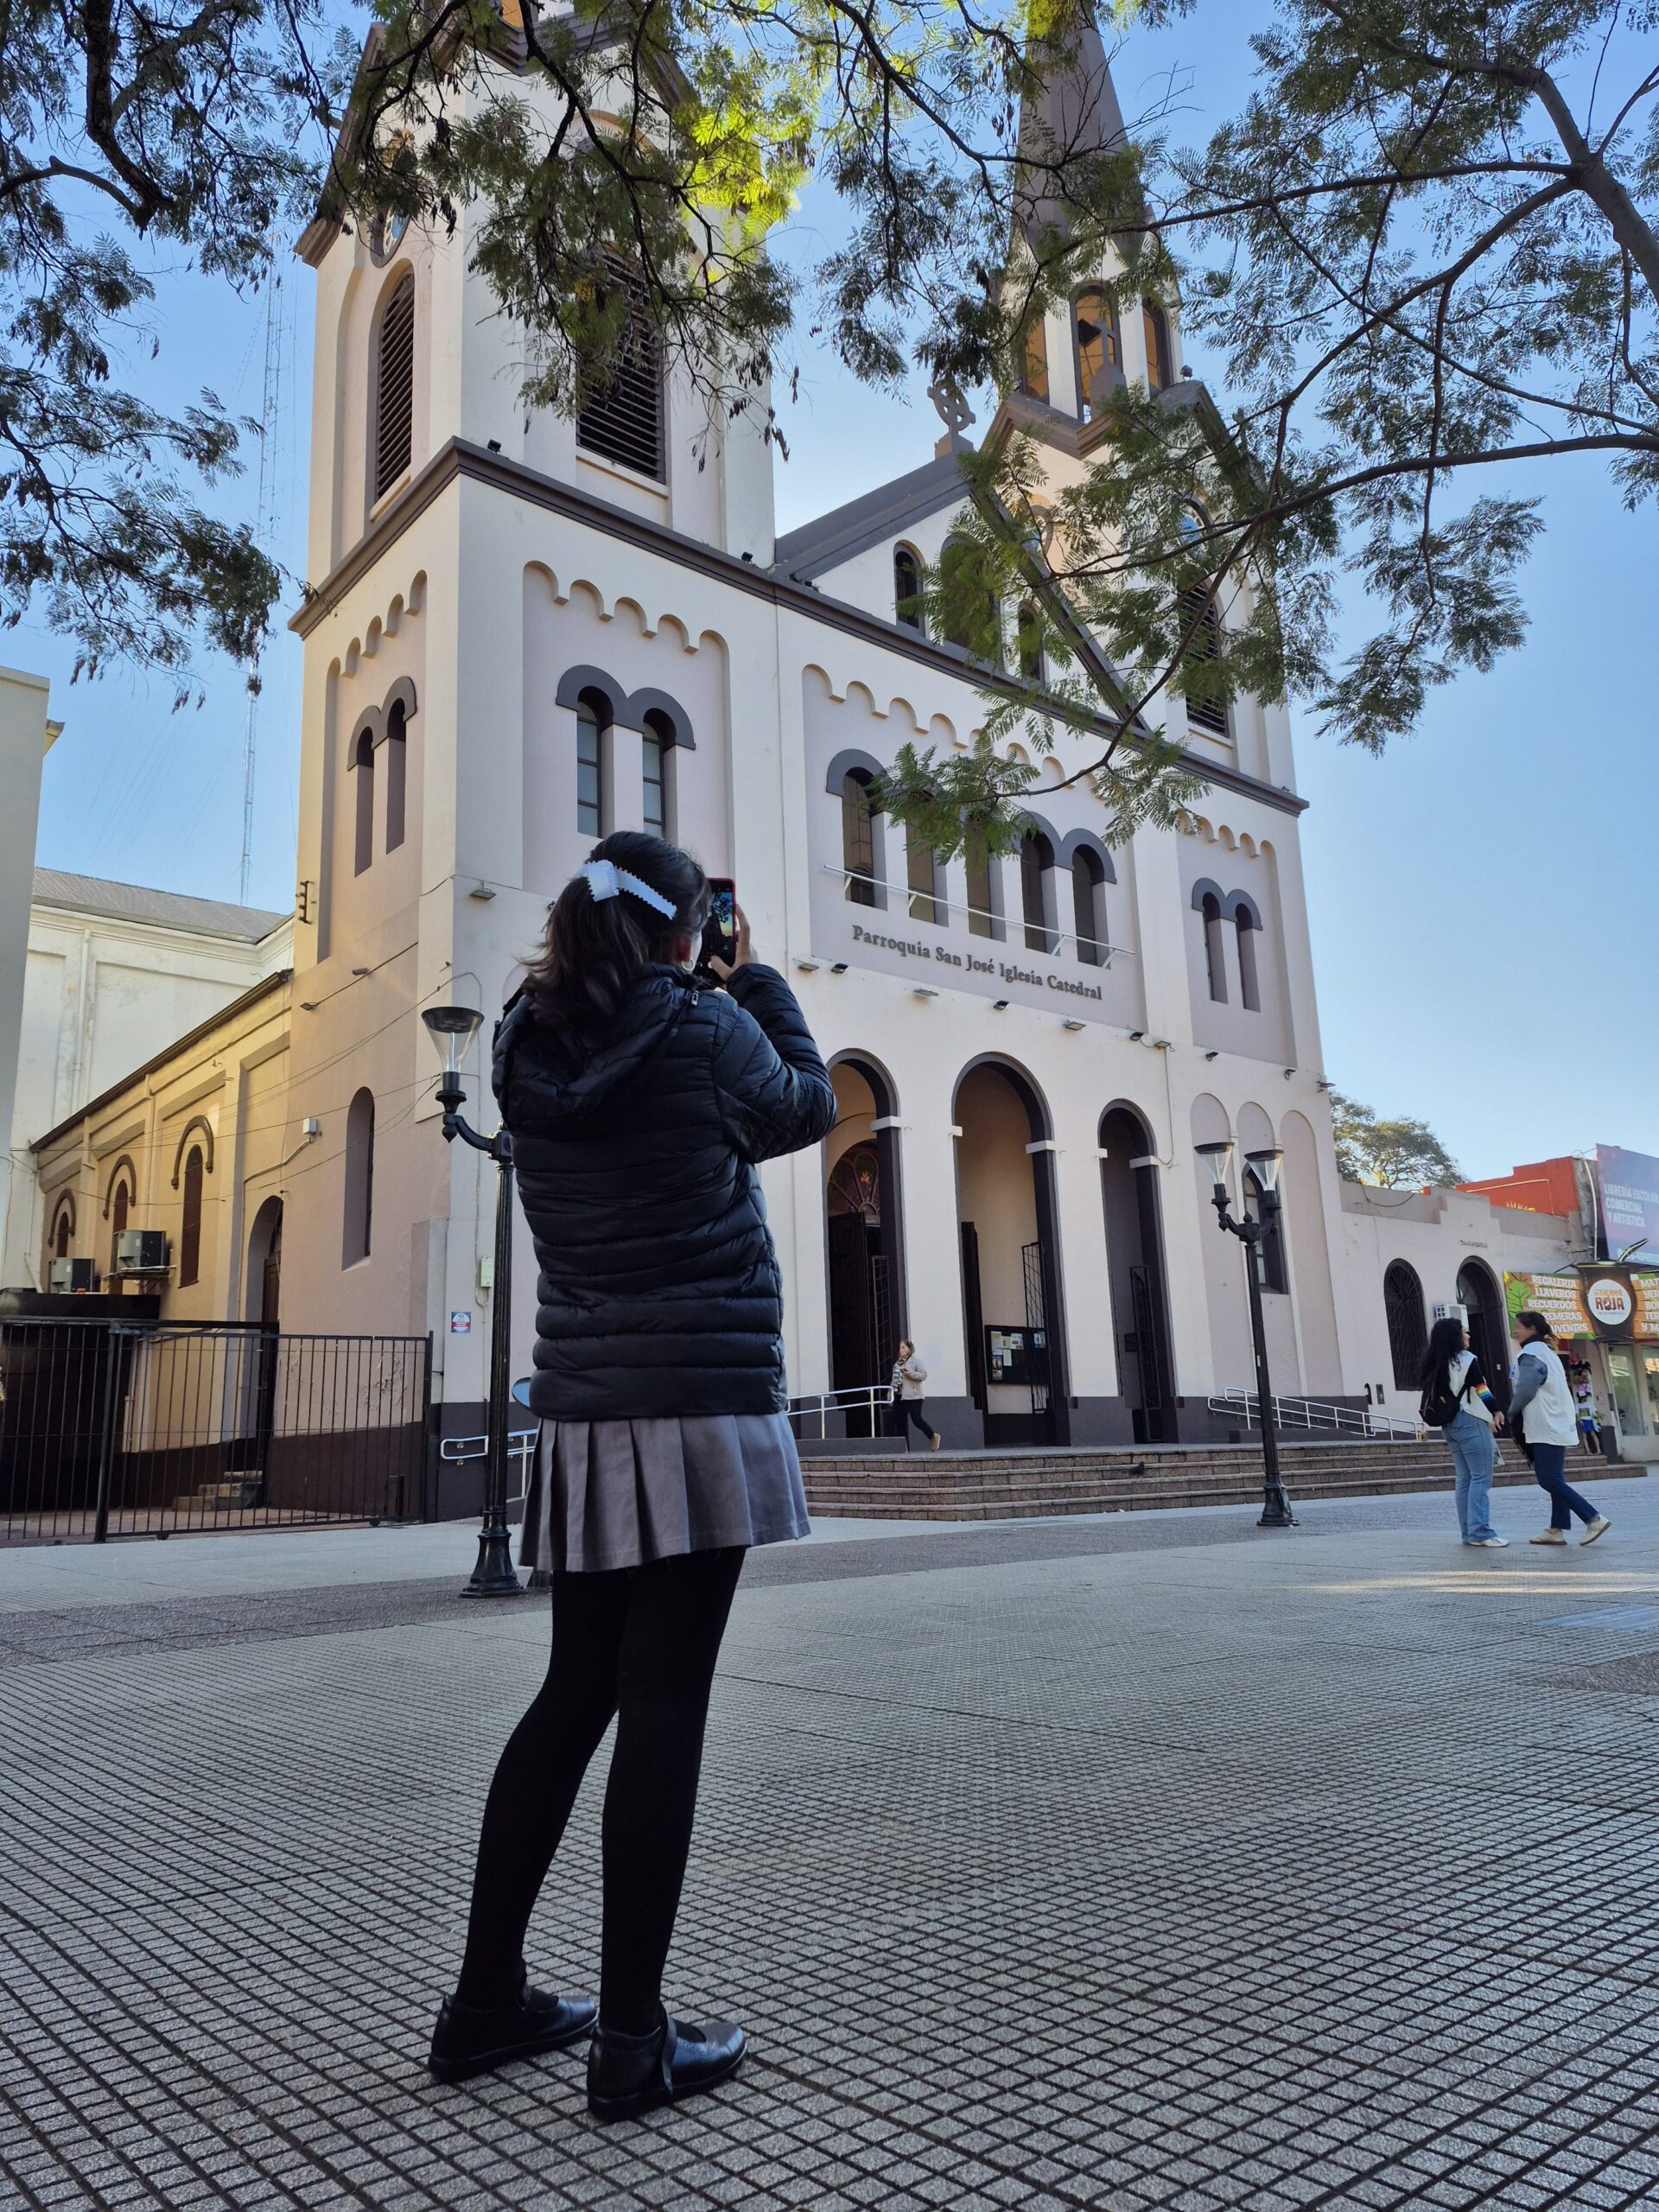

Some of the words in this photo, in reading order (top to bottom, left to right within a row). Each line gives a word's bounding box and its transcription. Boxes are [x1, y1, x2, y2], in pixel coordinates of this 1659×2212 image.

[852, 925, 931, 957] Parroquia
[935, 946, 962, 967] San
[965, 954, 995, 974] José
[999, 963, 1043, 985] Iglesia
[1046, 975, 1102, 1000] Catedral
[1632, 1188, 1659, 1204] ESCOLA
[1606, 1198, 1643, 1214] COMERCIAL
[1535, 1287, 1577, 1299] LLAVEROS
[1527, 1299, 1577, 1309] RECUERDOS
[1595, 1297, 1625, 1311] ROJA
